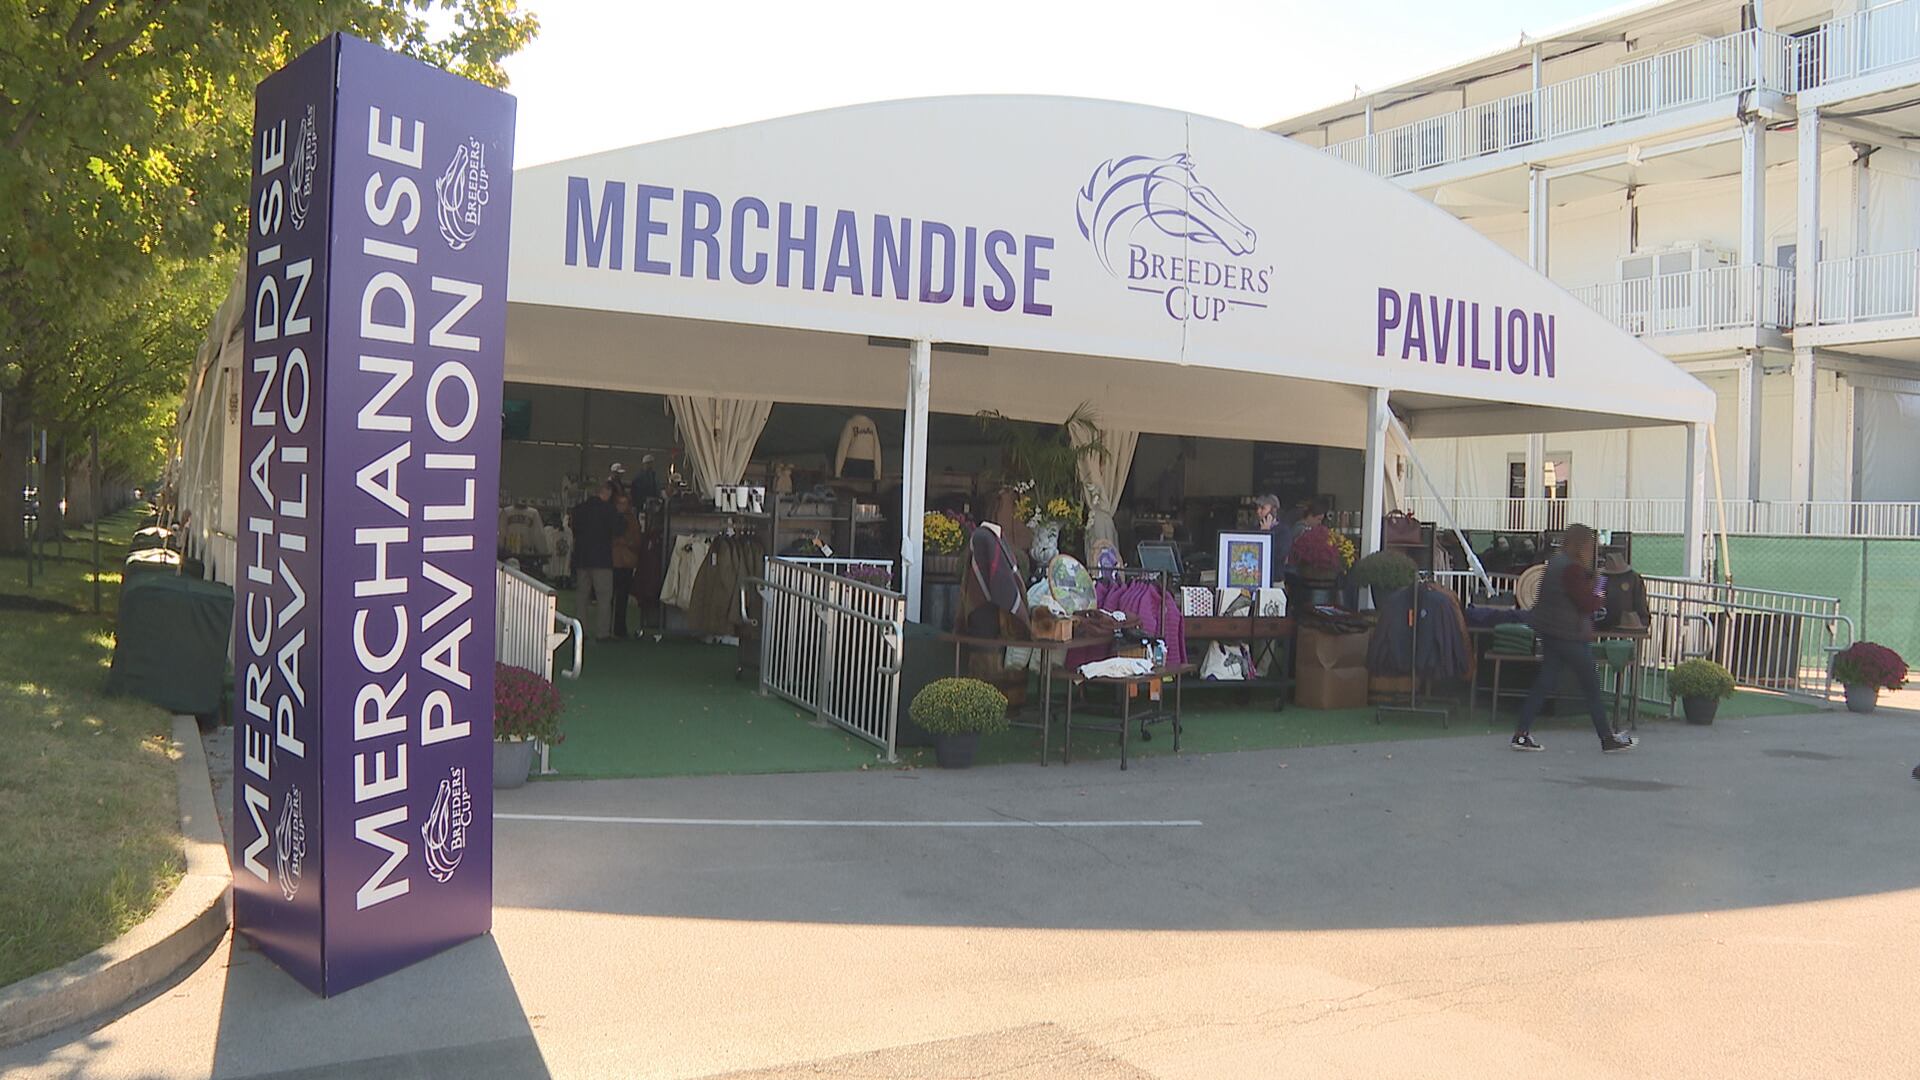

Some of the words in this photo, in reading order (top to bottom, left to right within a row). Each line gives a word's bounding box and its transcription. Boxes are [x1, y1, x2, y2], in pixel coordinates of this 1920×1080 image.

[465, 136, 480, 225] BREEDERS'
[477, 169, 489, 206] CUP
[564, 175, 1055, 317] MERCHANDISE
[1127, 243, 1274, 294] BREEDERS'
[1165, 286, 1226, 322] CUP
[1377, 287, 1556, 379] PAVILION
[243, 118, 287, 883] MERCHANDISE
[275, 257, 314, 759] PAVILION
[352, 105, 426, 912] MERCHANDISE
[420, 276, 484, 747] PAVILION
[450, 766, 462, 852] BREEDERS'
[460, 791, 473, 828] CUP
